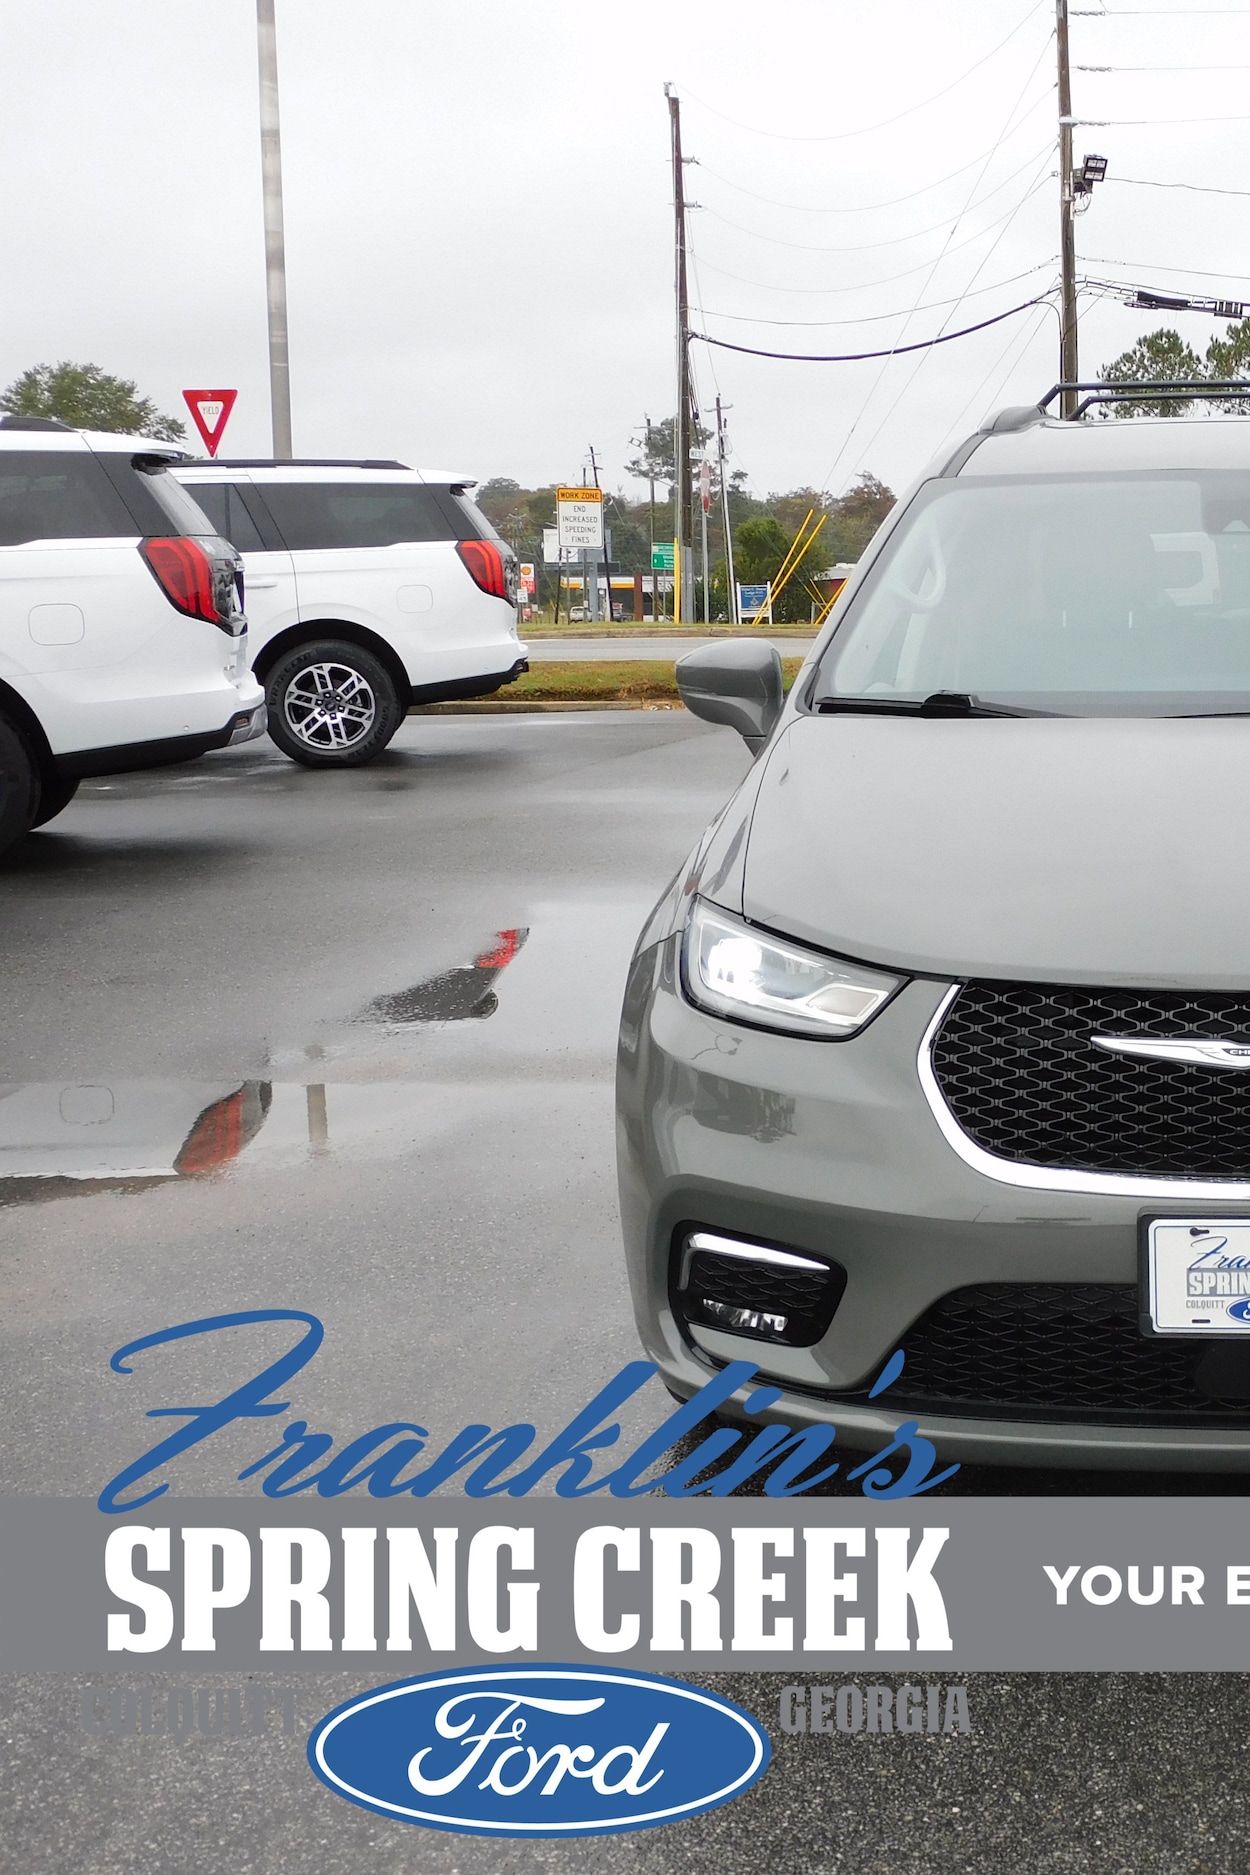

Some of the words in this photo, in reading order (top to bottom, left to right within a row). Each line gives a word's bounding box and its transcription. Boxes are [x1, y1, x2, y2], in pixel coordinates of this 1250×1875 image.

[202, 406, 220, 415] YIELD
[560, 491, 579, 499] WORK
[581, 492, 599, 500] ZONE
[573, 505, 586, 513] END
[571, 536, 590, 544] FINES
[1186, 1299, 1225, 1310] COLQUITT
